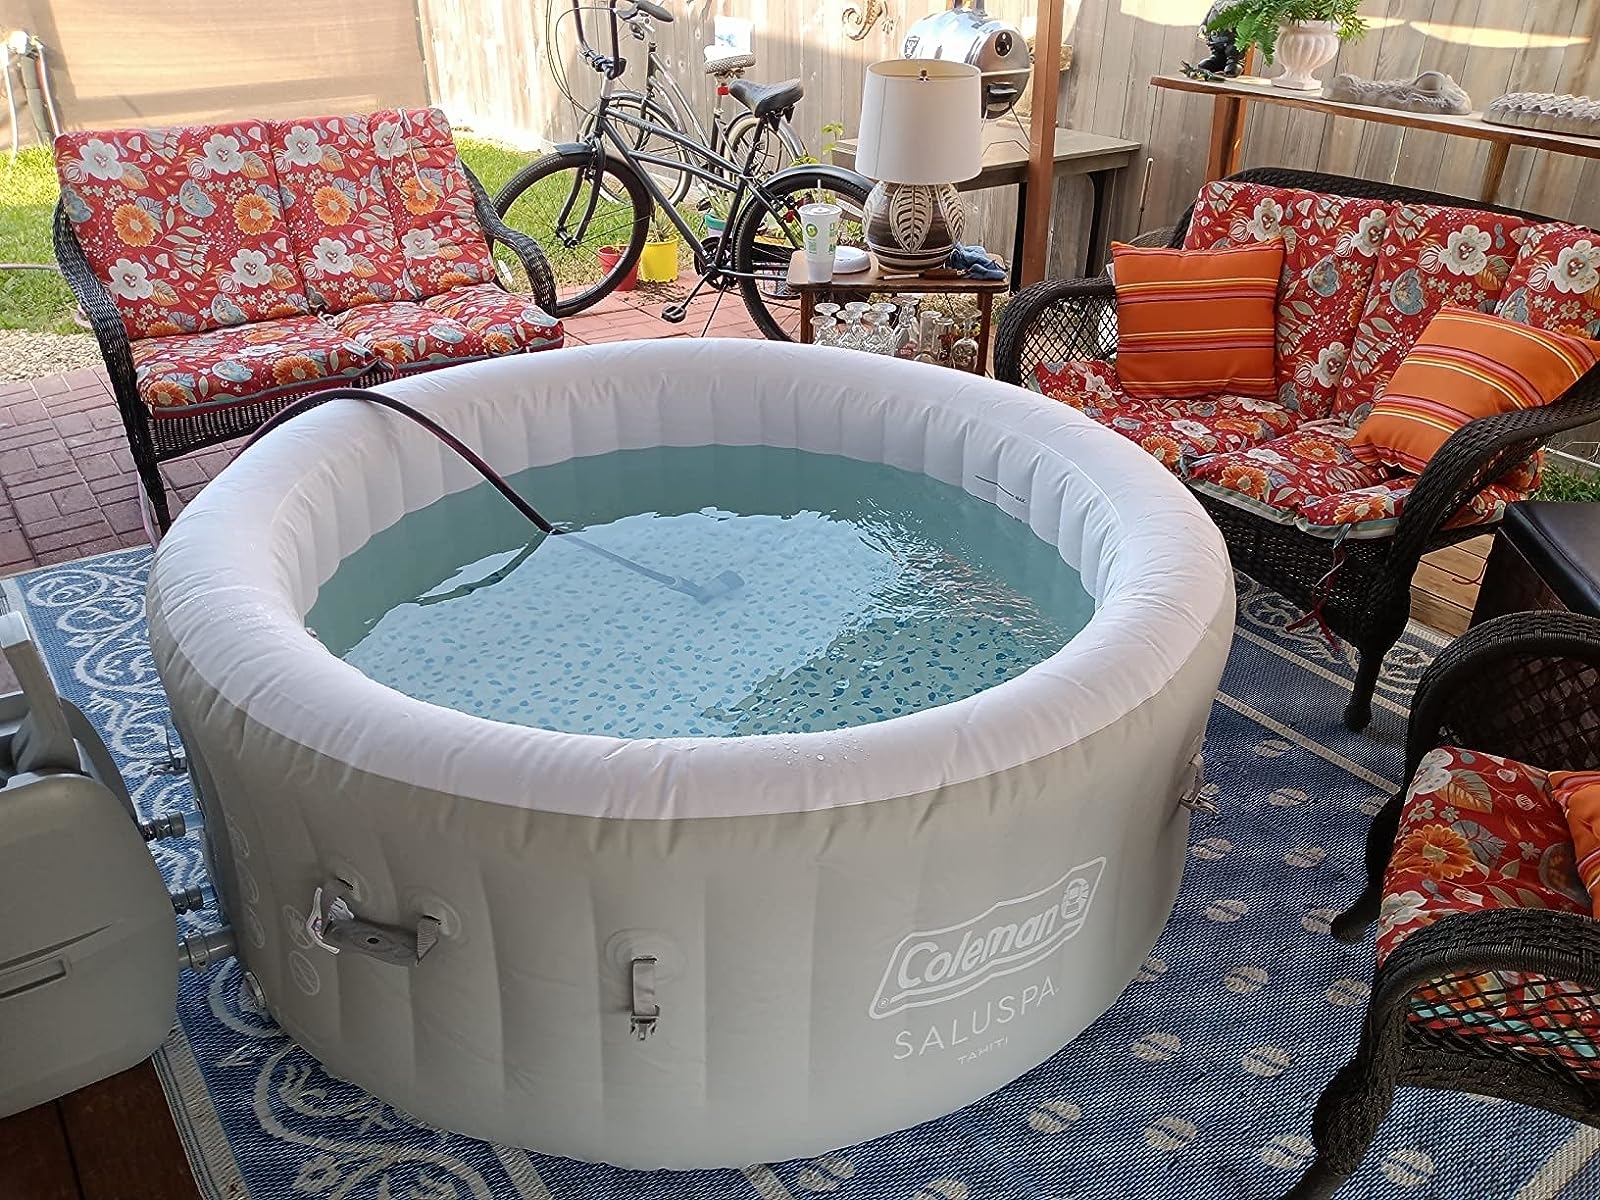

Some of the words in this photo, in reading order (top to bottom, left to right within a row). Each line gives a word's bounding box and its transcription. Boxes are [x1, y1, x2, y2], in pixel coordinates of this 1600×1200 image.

[898, 904, 1059, 988] Coleman
[894, 976, 1056, 1060] SALUSPA
[958, 1036, 1008, 1065] TAHITI
